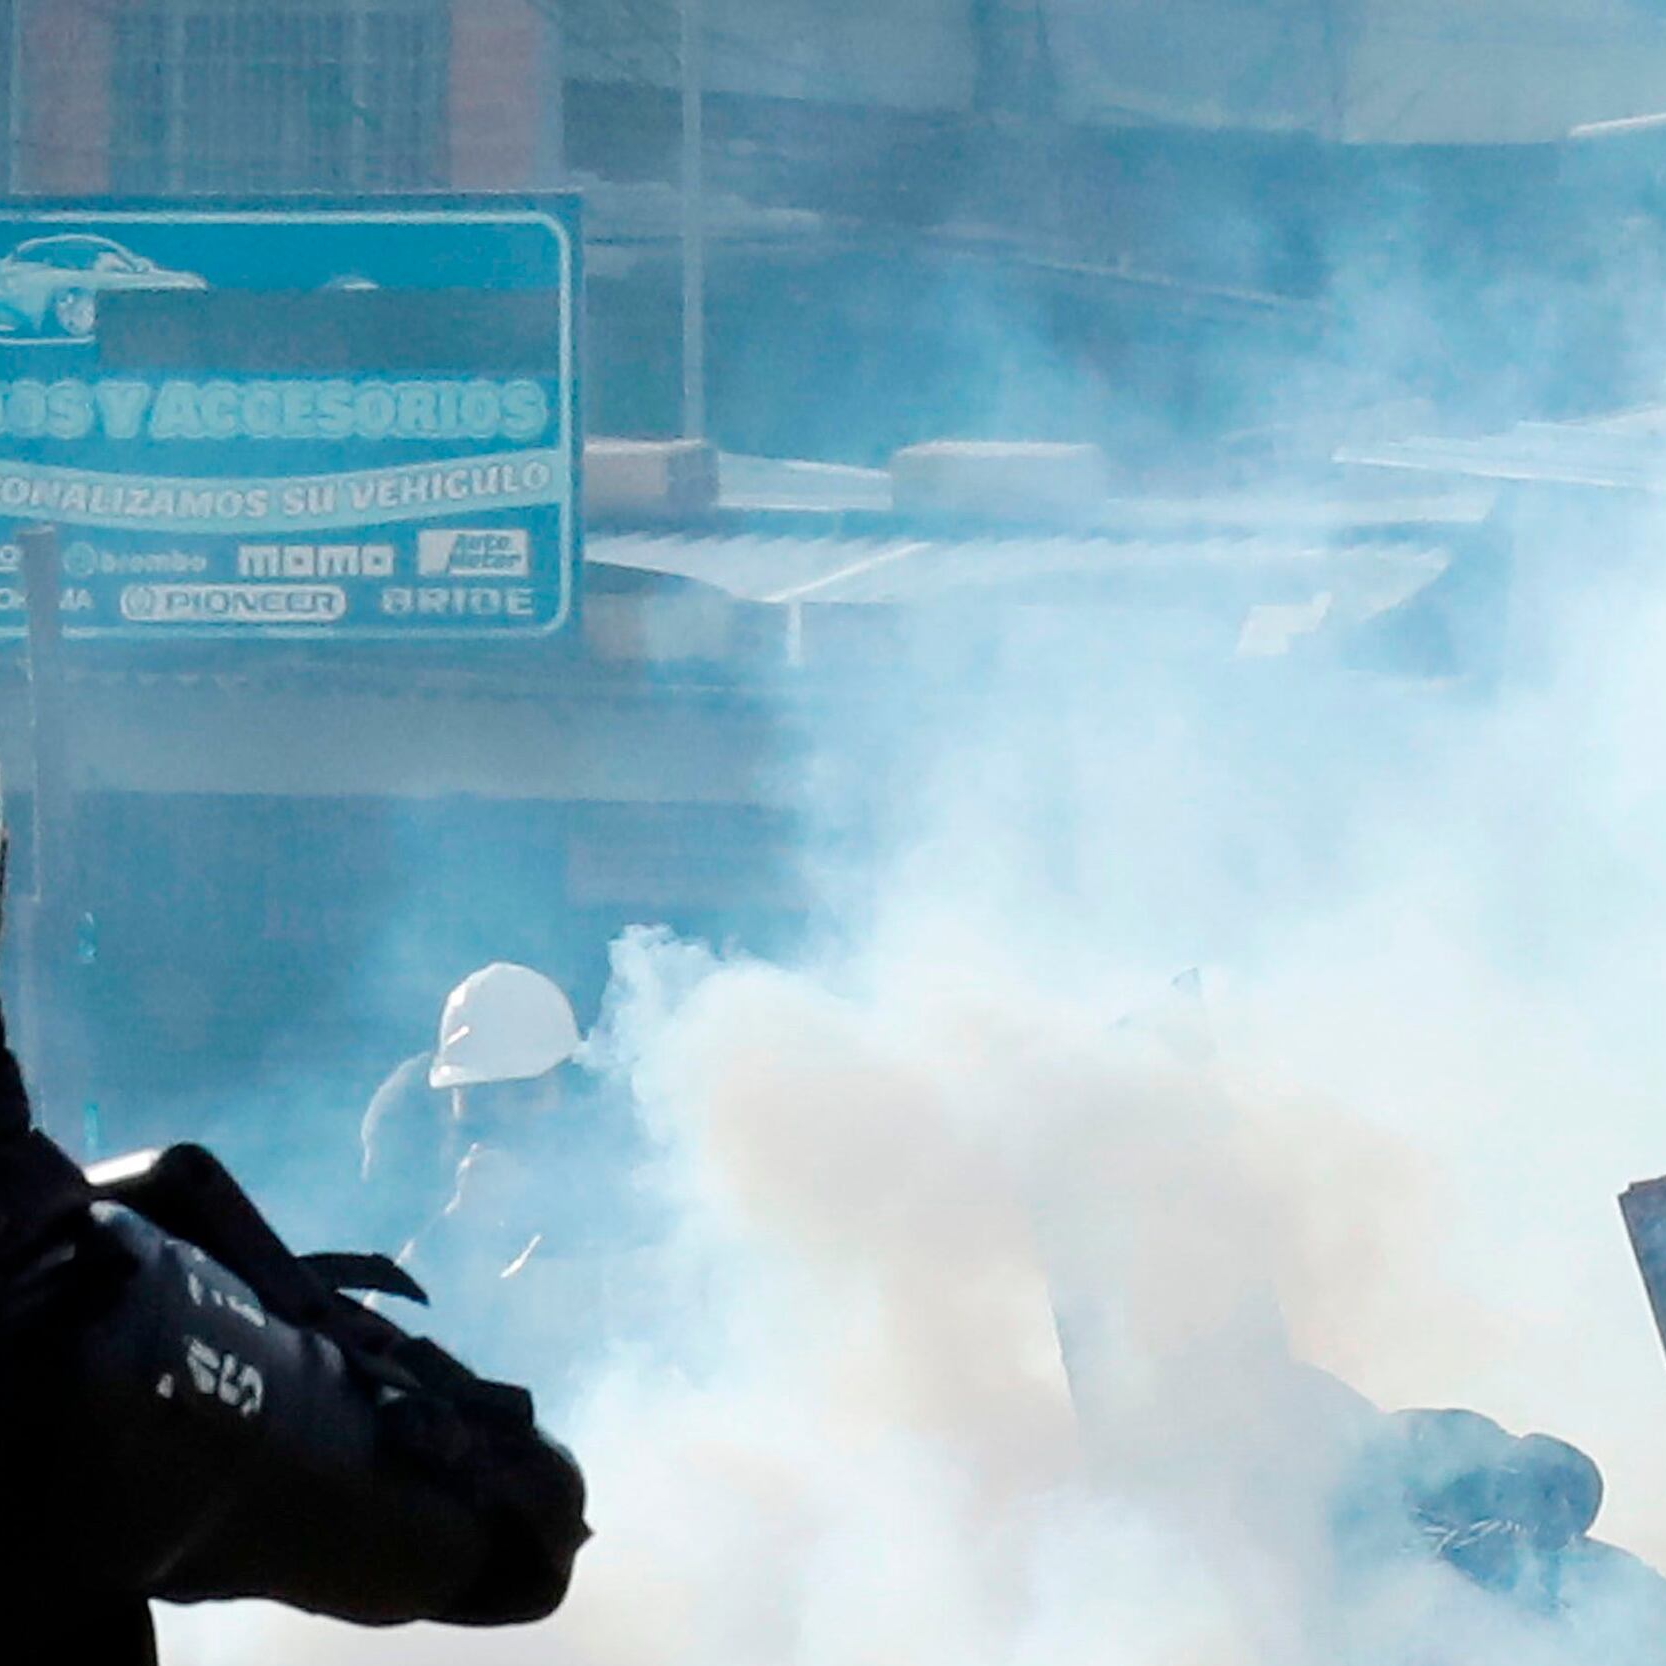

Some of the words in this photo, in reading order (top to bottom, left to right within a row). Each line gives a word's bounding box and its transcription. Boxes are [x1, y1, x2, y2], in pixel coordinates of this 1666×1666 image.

[97, 380, 150, 440] Y
[151, 378, 548, 440] ACCESORIOS
[281, 484, 336, 517] SU
[349, 460, 552, 512] VEHICULO
[165, 590, 334, 615] PIONEER
[381, 587, 534, 617] BRIDE
